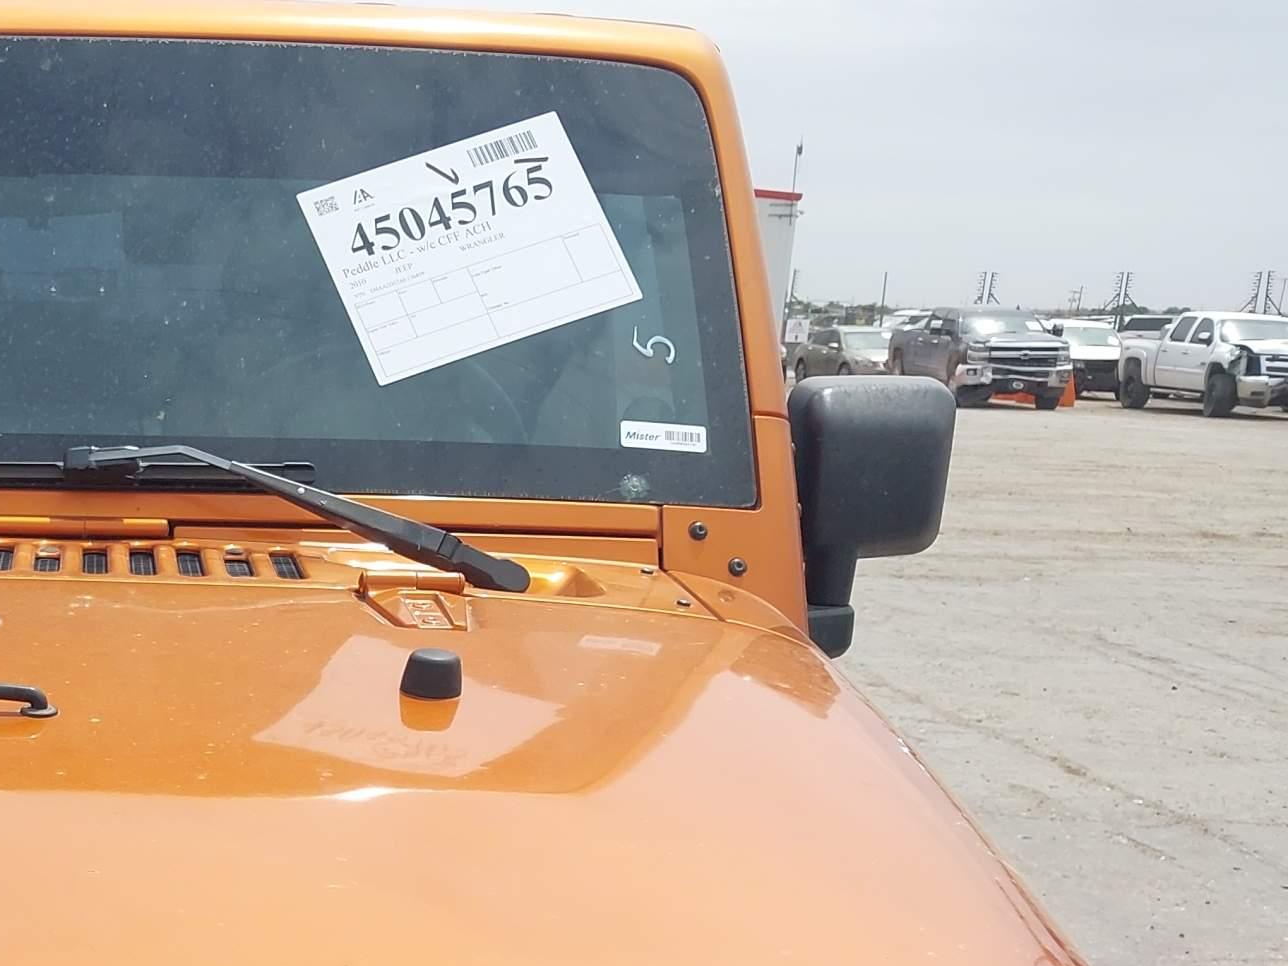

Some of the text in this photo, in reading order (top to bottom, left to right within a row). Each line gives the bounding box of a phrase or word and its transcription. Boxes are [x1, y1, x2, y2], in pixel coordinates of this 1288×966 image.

[351, 164, 553, 256] 45045765
[342, 260, 379, 279] Peddle
[381, 248, 407, 266] LLC
[465, 221, 492, 239] ACH
[458, 231, 505, 252] WRANGLER
[625, 431, 661, 441] Mister
